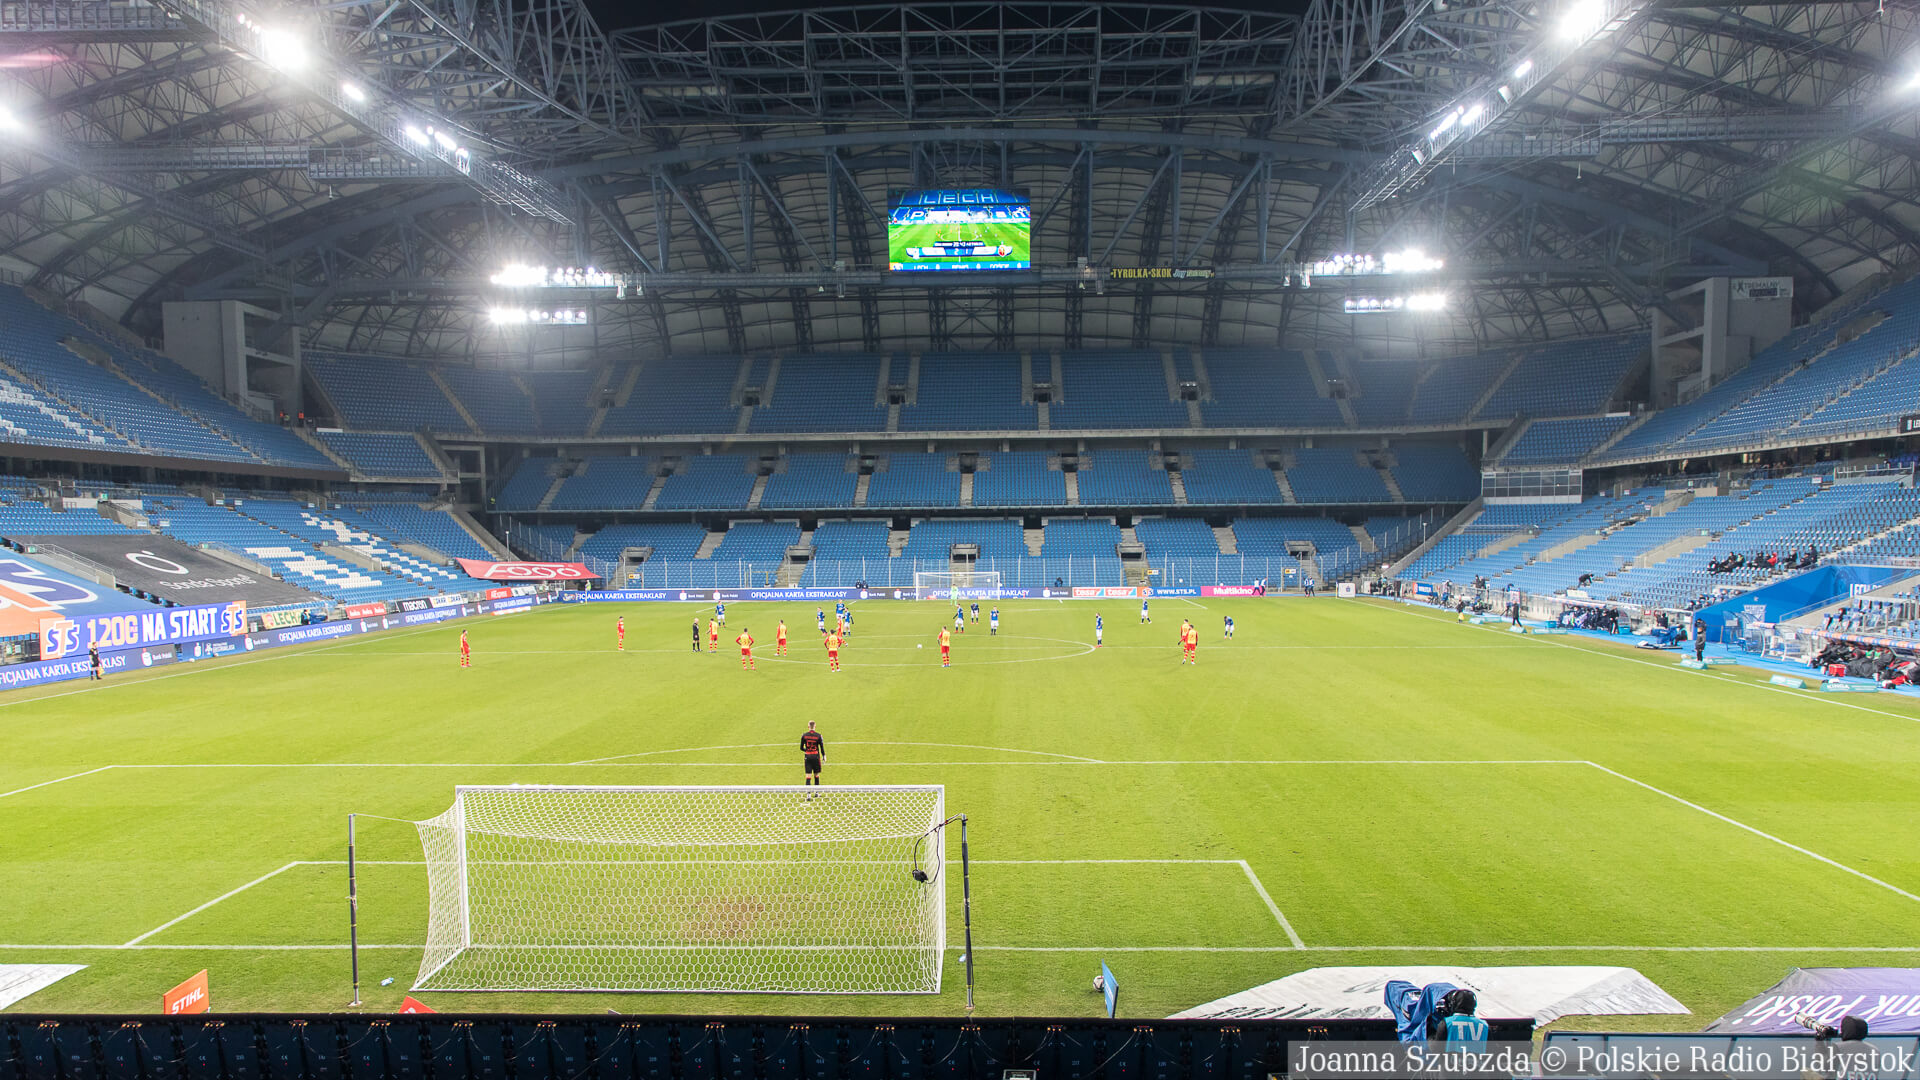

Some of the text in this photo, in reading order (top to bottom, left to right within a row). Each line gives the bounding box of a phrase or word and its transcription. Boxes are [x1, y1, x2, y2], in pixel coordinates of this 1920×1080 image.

[924, 194, 994, 204] LECH
[1213, 587, 1253, 595] Multikino
[402, 600, 428, 611] macron
[46, 619, 80, 656] STS
[142, 613, 166, 642] NA
[170, 607, 218, 639] START
[221, 604, 245, 634] STS
[42, 663, 71, 678] KARTA
[171, 987, 205, 1014] STIHL
[1451, 1021, 1484, 1042] TV
